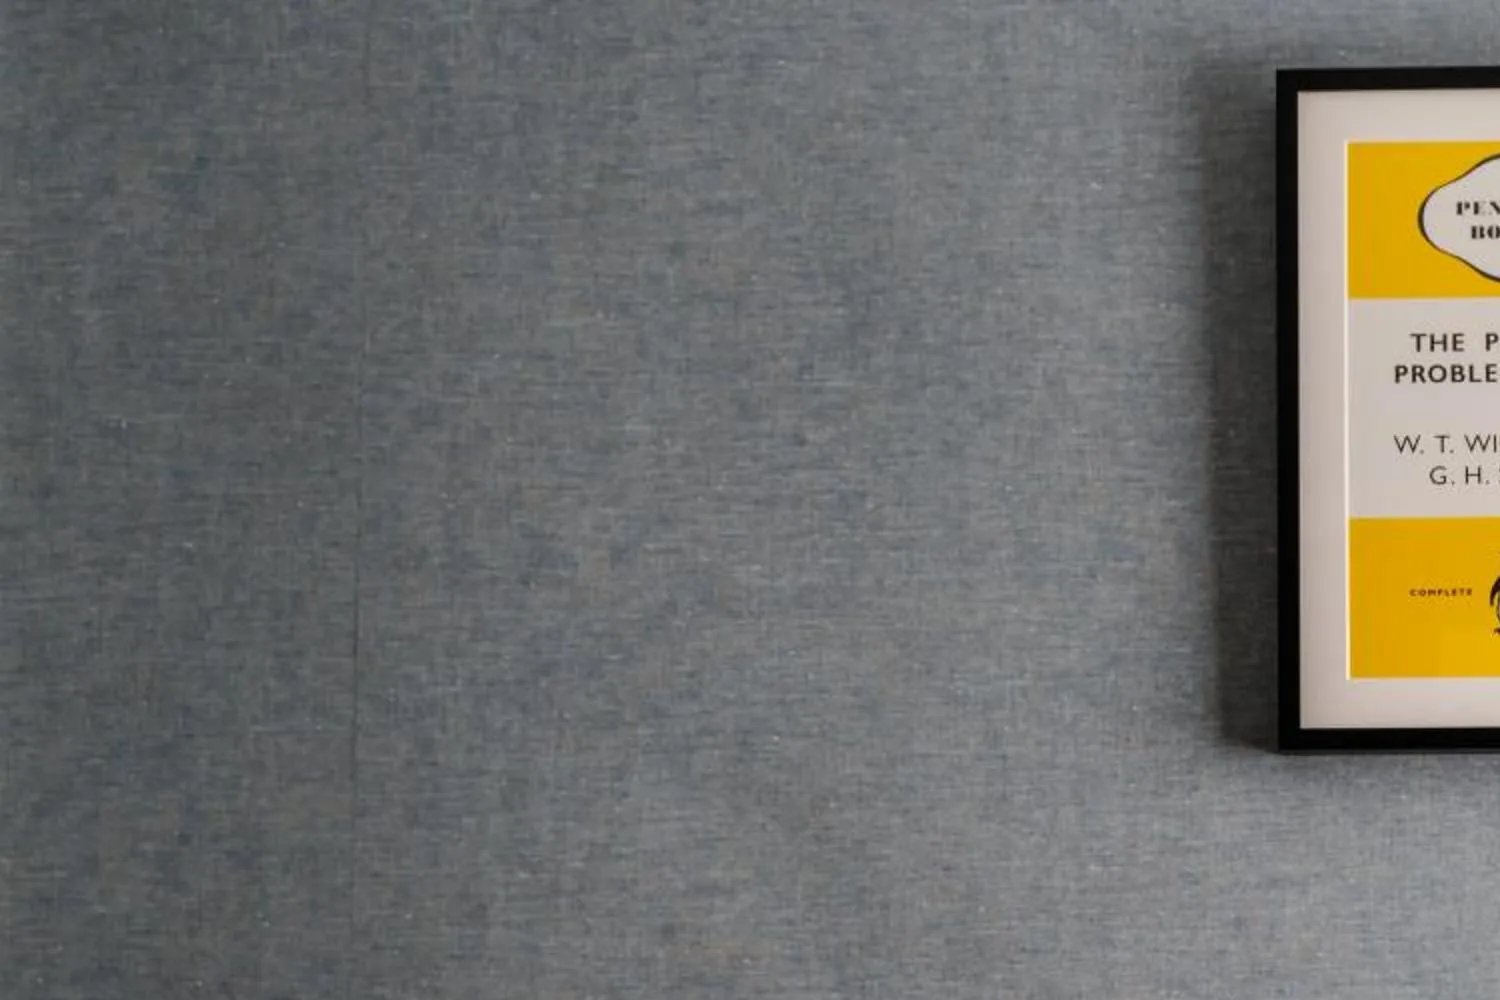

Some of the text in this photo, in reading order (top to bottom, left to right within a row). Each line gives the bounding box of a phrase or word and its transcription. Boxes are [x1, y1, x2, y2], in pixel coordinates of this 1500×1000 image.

[1409, 332, 1465, 353] THE
[1393, 434, 1425, 454] W.
[1433, 434, 1455, 454] T.
[1428, 465, 1456, 486] G.
[1464, 465, 1489, 485] H.
[1409, 587, 1473, 598] COMPLETE
